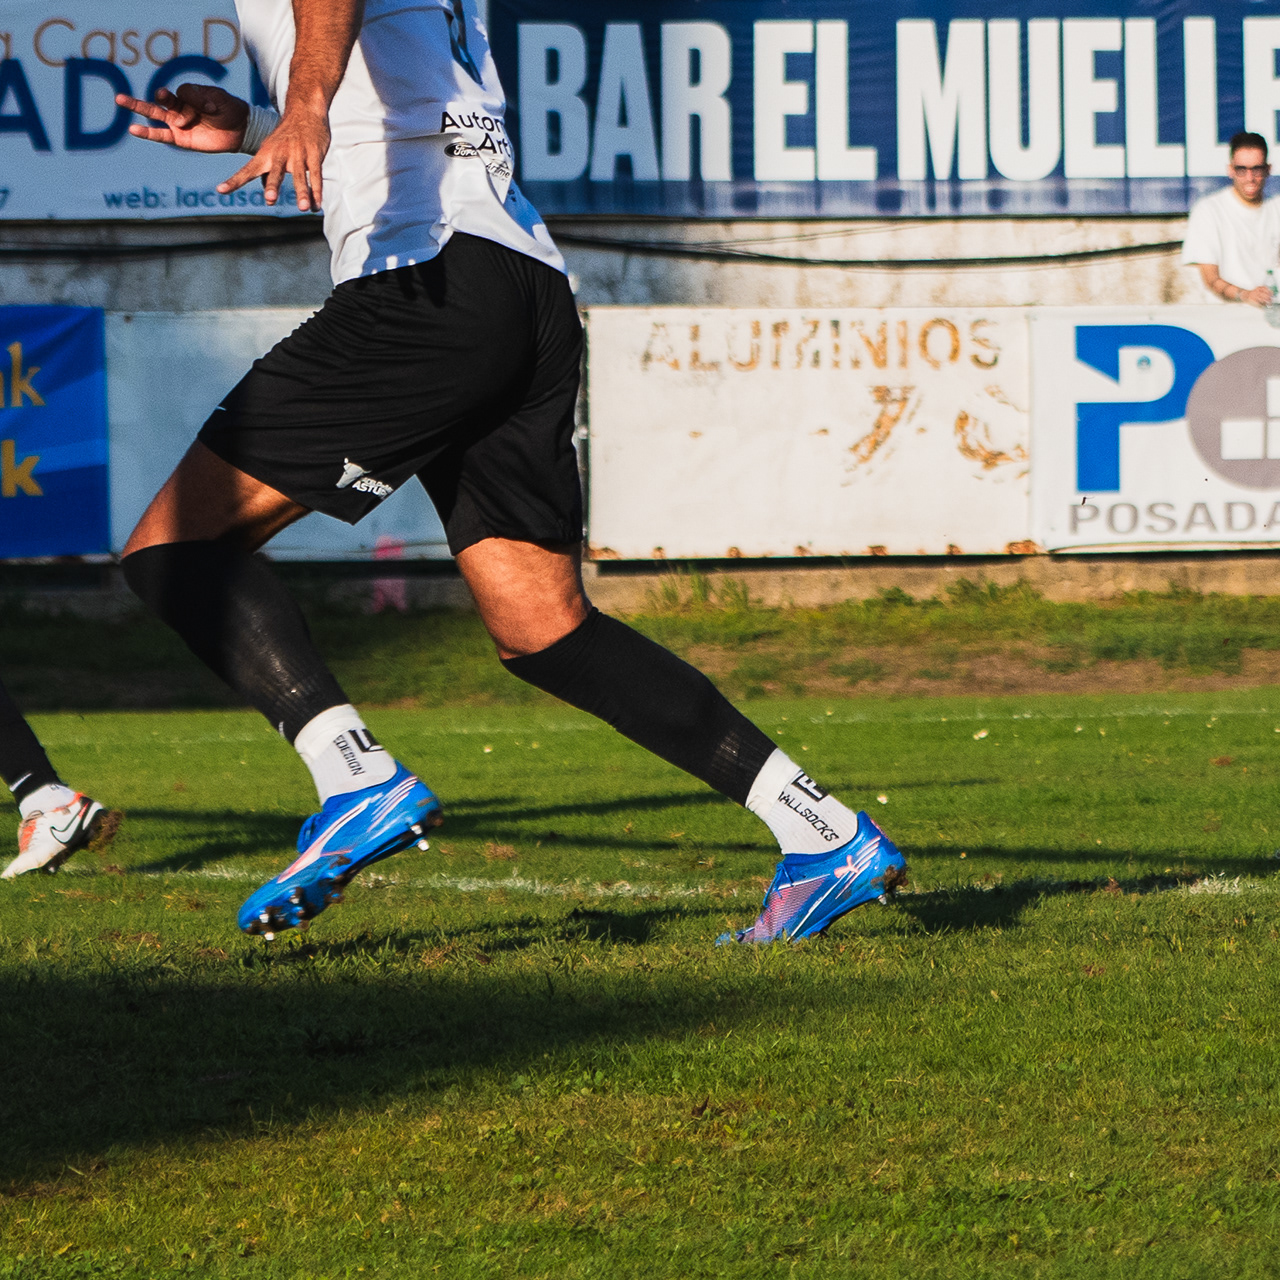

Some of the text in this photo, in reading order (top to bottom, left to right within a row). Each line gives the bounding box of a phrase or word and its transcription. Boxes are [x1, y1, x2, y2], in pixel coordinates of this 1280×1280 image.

[32, 19, 178, 68] Casa
[517, 22, 732, 182] BAR
[754, 20, 878, 180] EL
[103, 186, 168, 210] web:
